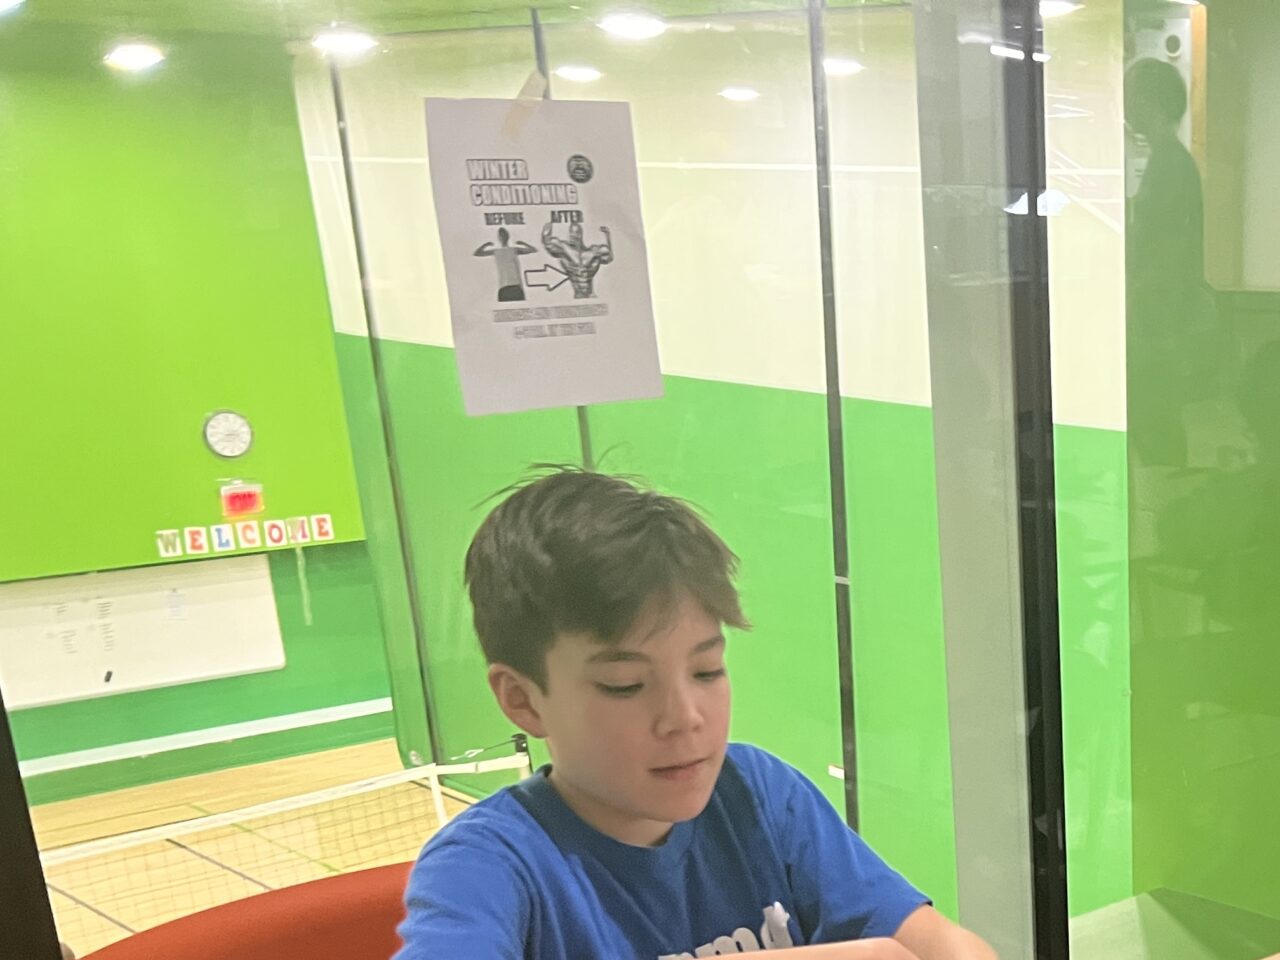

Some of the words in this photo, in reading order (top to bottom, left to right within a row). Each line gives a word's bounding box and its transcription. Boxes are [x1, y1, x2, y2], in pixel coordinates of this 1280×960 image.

[466, 159, 528, 180] WINTER
[470, 183, 578, 206] CONDITIONING
[551, 210, 583, 223] AFTER
[158, 517, 330, 554] WELCOME
